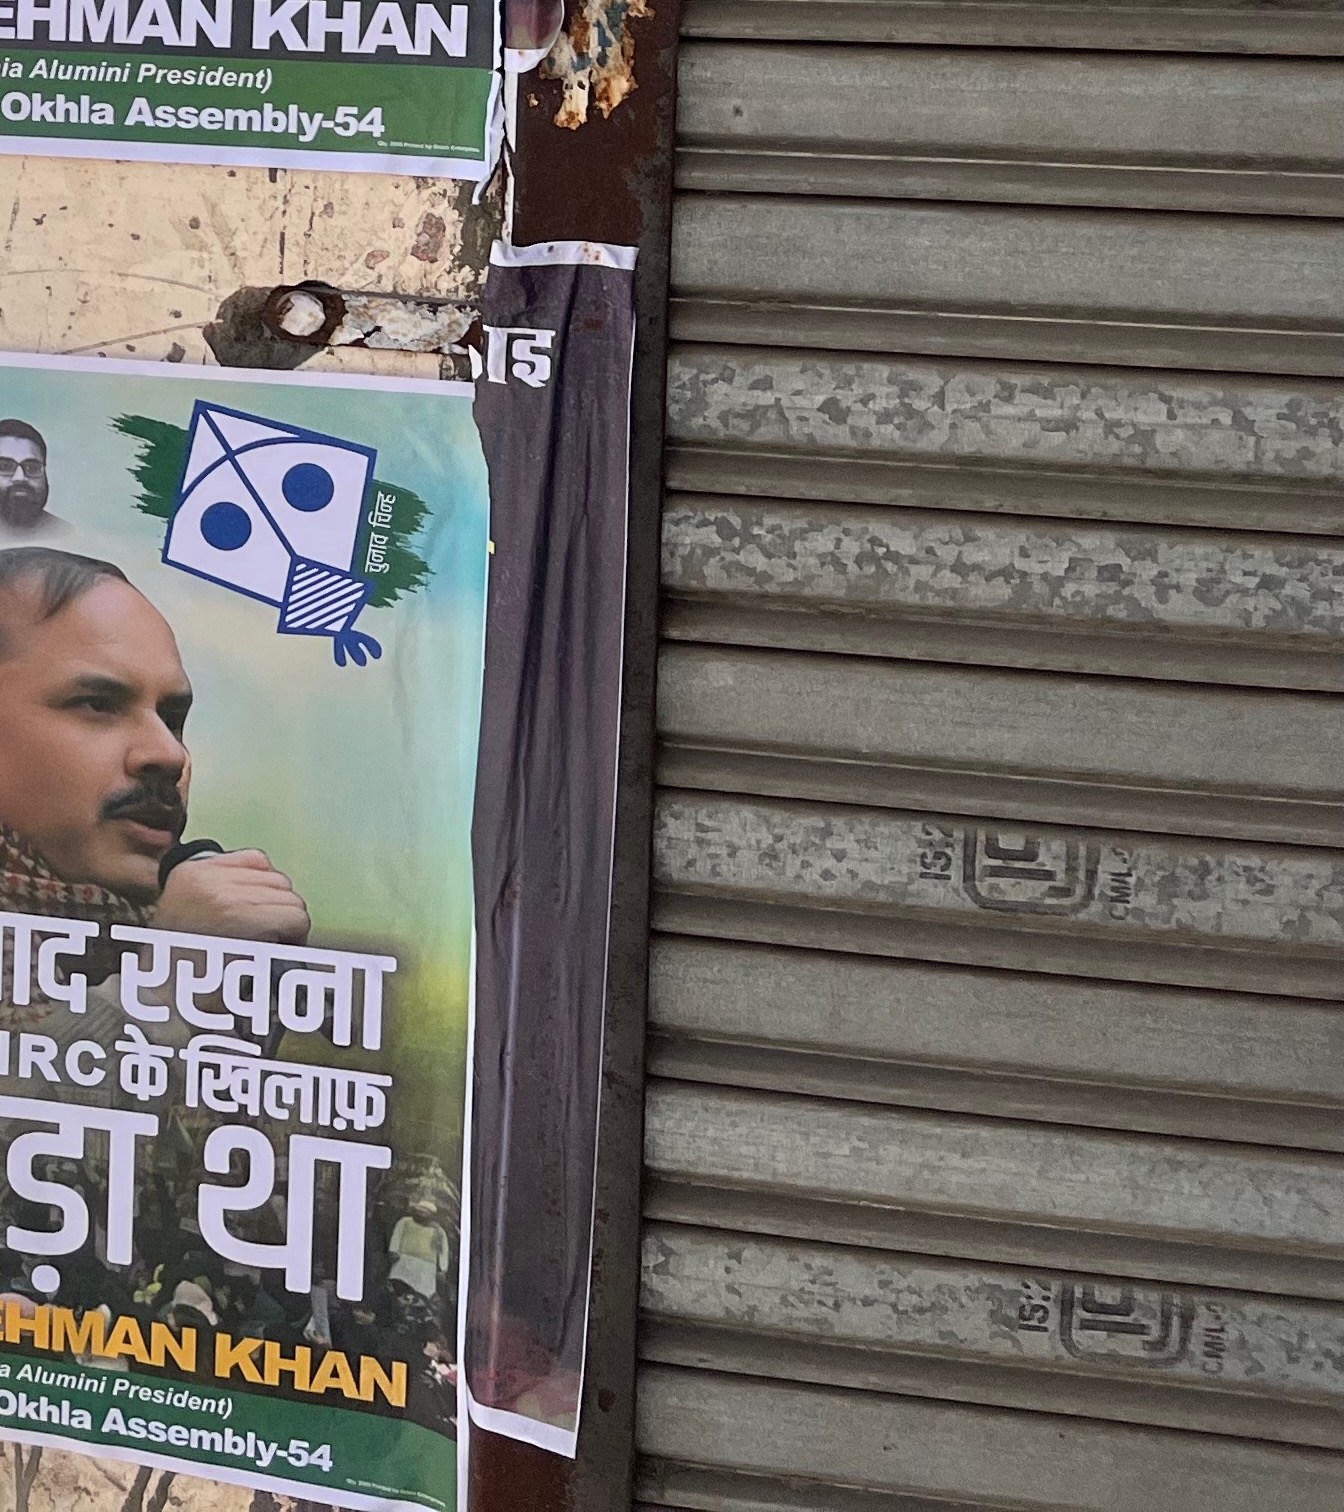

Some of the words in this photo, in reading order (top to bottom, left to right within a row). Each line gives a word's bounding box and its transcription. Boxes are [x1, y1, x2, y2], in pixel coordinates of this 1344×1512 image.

[28, 58, 131, 84] Alumini
[137, 63, 273, 94] President)
[1, 91, 115, 125] Okhla
[124, 97, 387, 147] Assembly-54
[364, 531, 390, 574] चुनाव
[110, 924, 398, 1051] रखना
[114, 1023, 175, 1102] के
[178, 1034, 393, 1132] खिलाफ़
[197, 1123, 392, 1302] था
[16, 1364, 107, 1394] Alumini
[112, 1378, 233, 1420] President)
[214, 1332, 408, 1408] KHAN
[101, 1407, 333, 1472] Assembly-54
